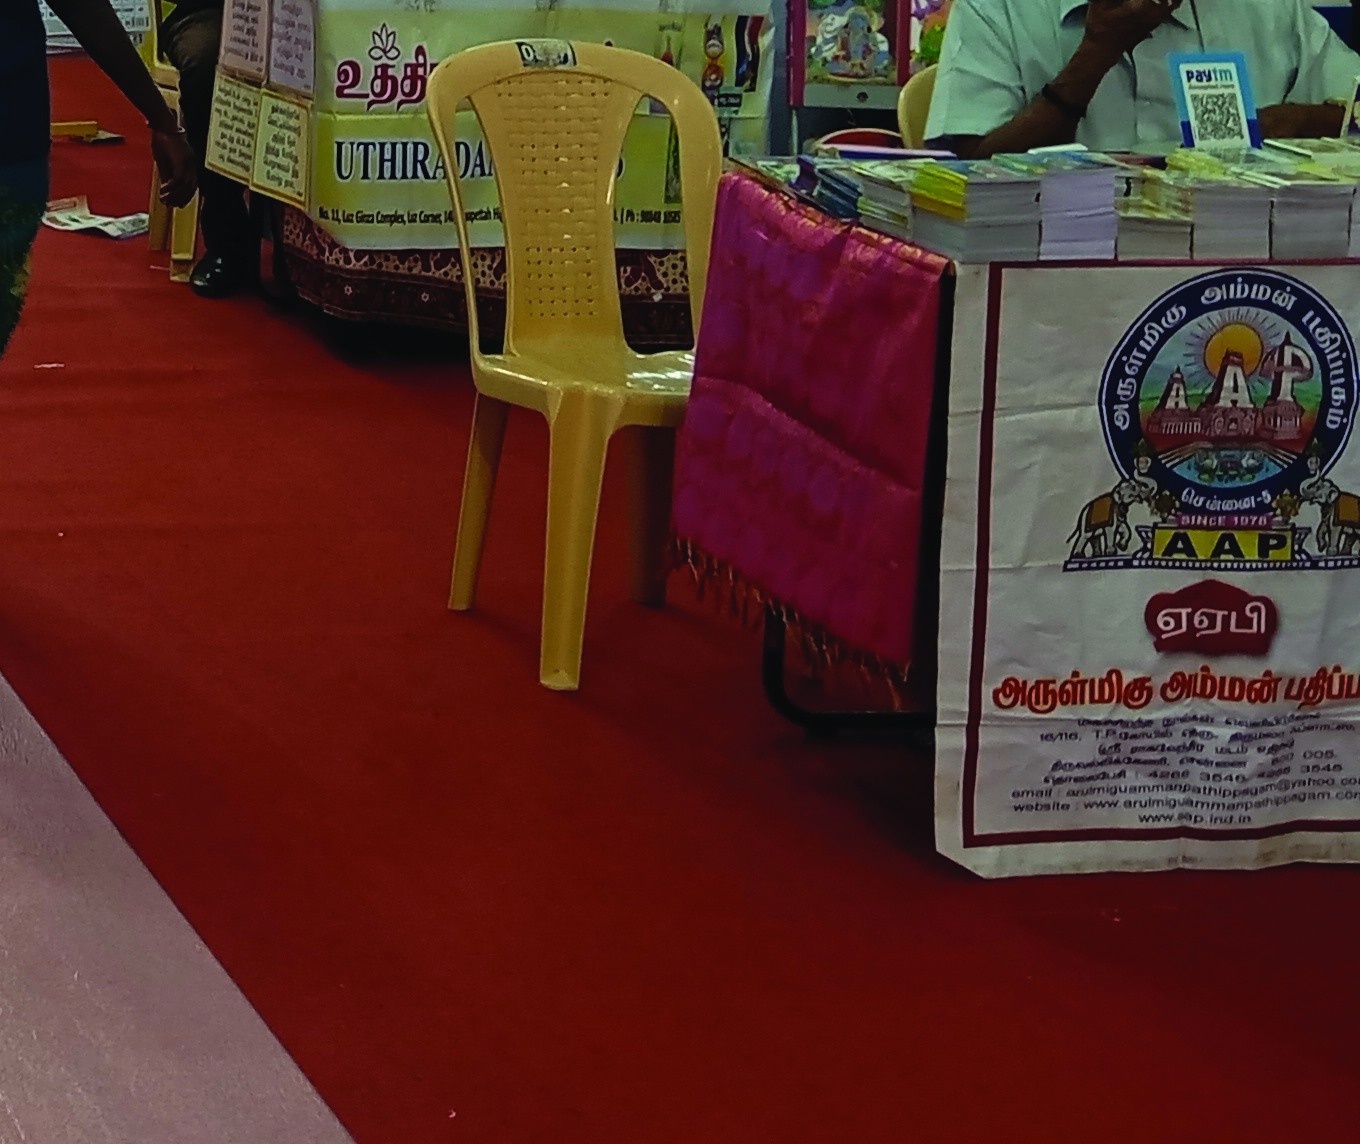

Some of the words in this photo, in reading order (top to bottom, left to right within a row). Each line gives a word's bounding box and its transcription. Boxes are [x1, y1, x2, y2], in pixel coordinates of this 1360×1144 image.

[335, 44, 428, 112] உத்தி
[1185, 67, 1233, 83] paytm
[334, 140, 495, 182] UTHIRADA
[1200, 277, 1296, 312] அம்மன்
[1181, 514, 1228, 526] SINCE
[992, 667, 1155, 714] அருள்மிகு
[1160, 663, 1281, 708] அம்மன்
[1011, 787, 1053, 799] email
[1013, 801, 1071, 813] website
